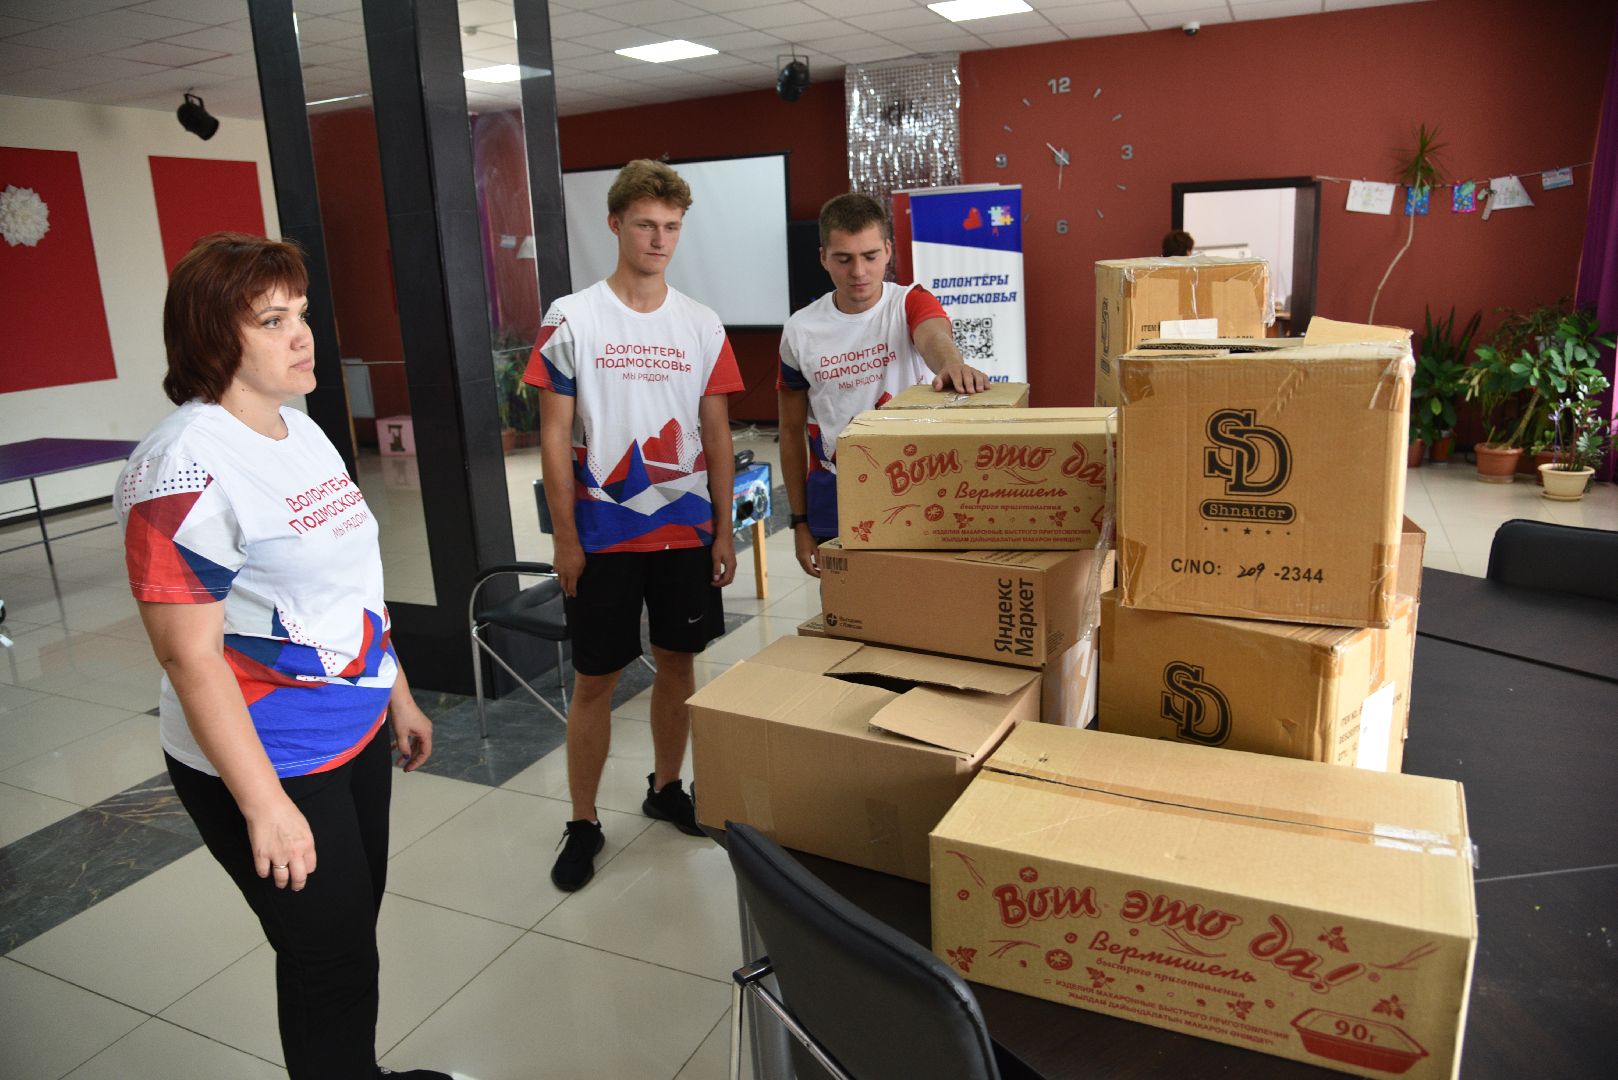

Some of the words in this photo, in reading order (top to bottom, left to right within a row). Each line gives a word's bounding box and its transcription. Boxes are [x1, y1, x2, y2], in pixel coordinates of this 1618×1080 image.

[1048, 77, 1071, 94] 12
[995, 153, 1008, 168] 9
[1121, 144, 1133, 160] 3
[1056, 219, 1069, 234] 6
[932, 274, 1009, 289] ВОЛОНТЁРЫ
[935, 291, 1017, 306] ОДМОСКОВЬЯ
[605, 343, 686, 360] ВОЛОНТЕРЫ
[595, 357, 693, 374] ПОДМОСКОВЬЯ
[622, 372, 636, 381] МЫ
[637, 373, 669, 383] РЯДОМ
[838, 381, 854, 391] МЫ
[1204, 408, 1292, 497] SD
[885, 448, 962, 496] Вот
[975, 444, 1056, 470] это
[954, 480, 1068, 504] Вермишель
[1208, 503, 1287, 520] Shnaider
[1171, 558, 1222, 576] C/NO:
[994, 578, 1015, 653] Яндекс
[1015, 577, 1037, 657] Маркет
[1161, 660, 1232, 747] SD
[992, 883, 1102, 928] Вот
[1120, 889, 1243, 940] это
[1249, 914, 1367, 994] да!
[1088, 930, 1257, 982] Вермишель
[1096, 957, 1152, 977] быстрого
[1154, 971, 1246, 998] приготовления
[1056, 979, 1095, 994] ИЗДЕЛИЯ
[1095, 988, 1157, 1010] МАКАРОННЫЕ
[1158, 1003, 1208, 1021] БЫСТРОГО
[1209, 1015, 1290, 1040] ПРИГОТОВЛЕНИЯ
[1184, 1019, 1229, 1035] МАКАРОН
